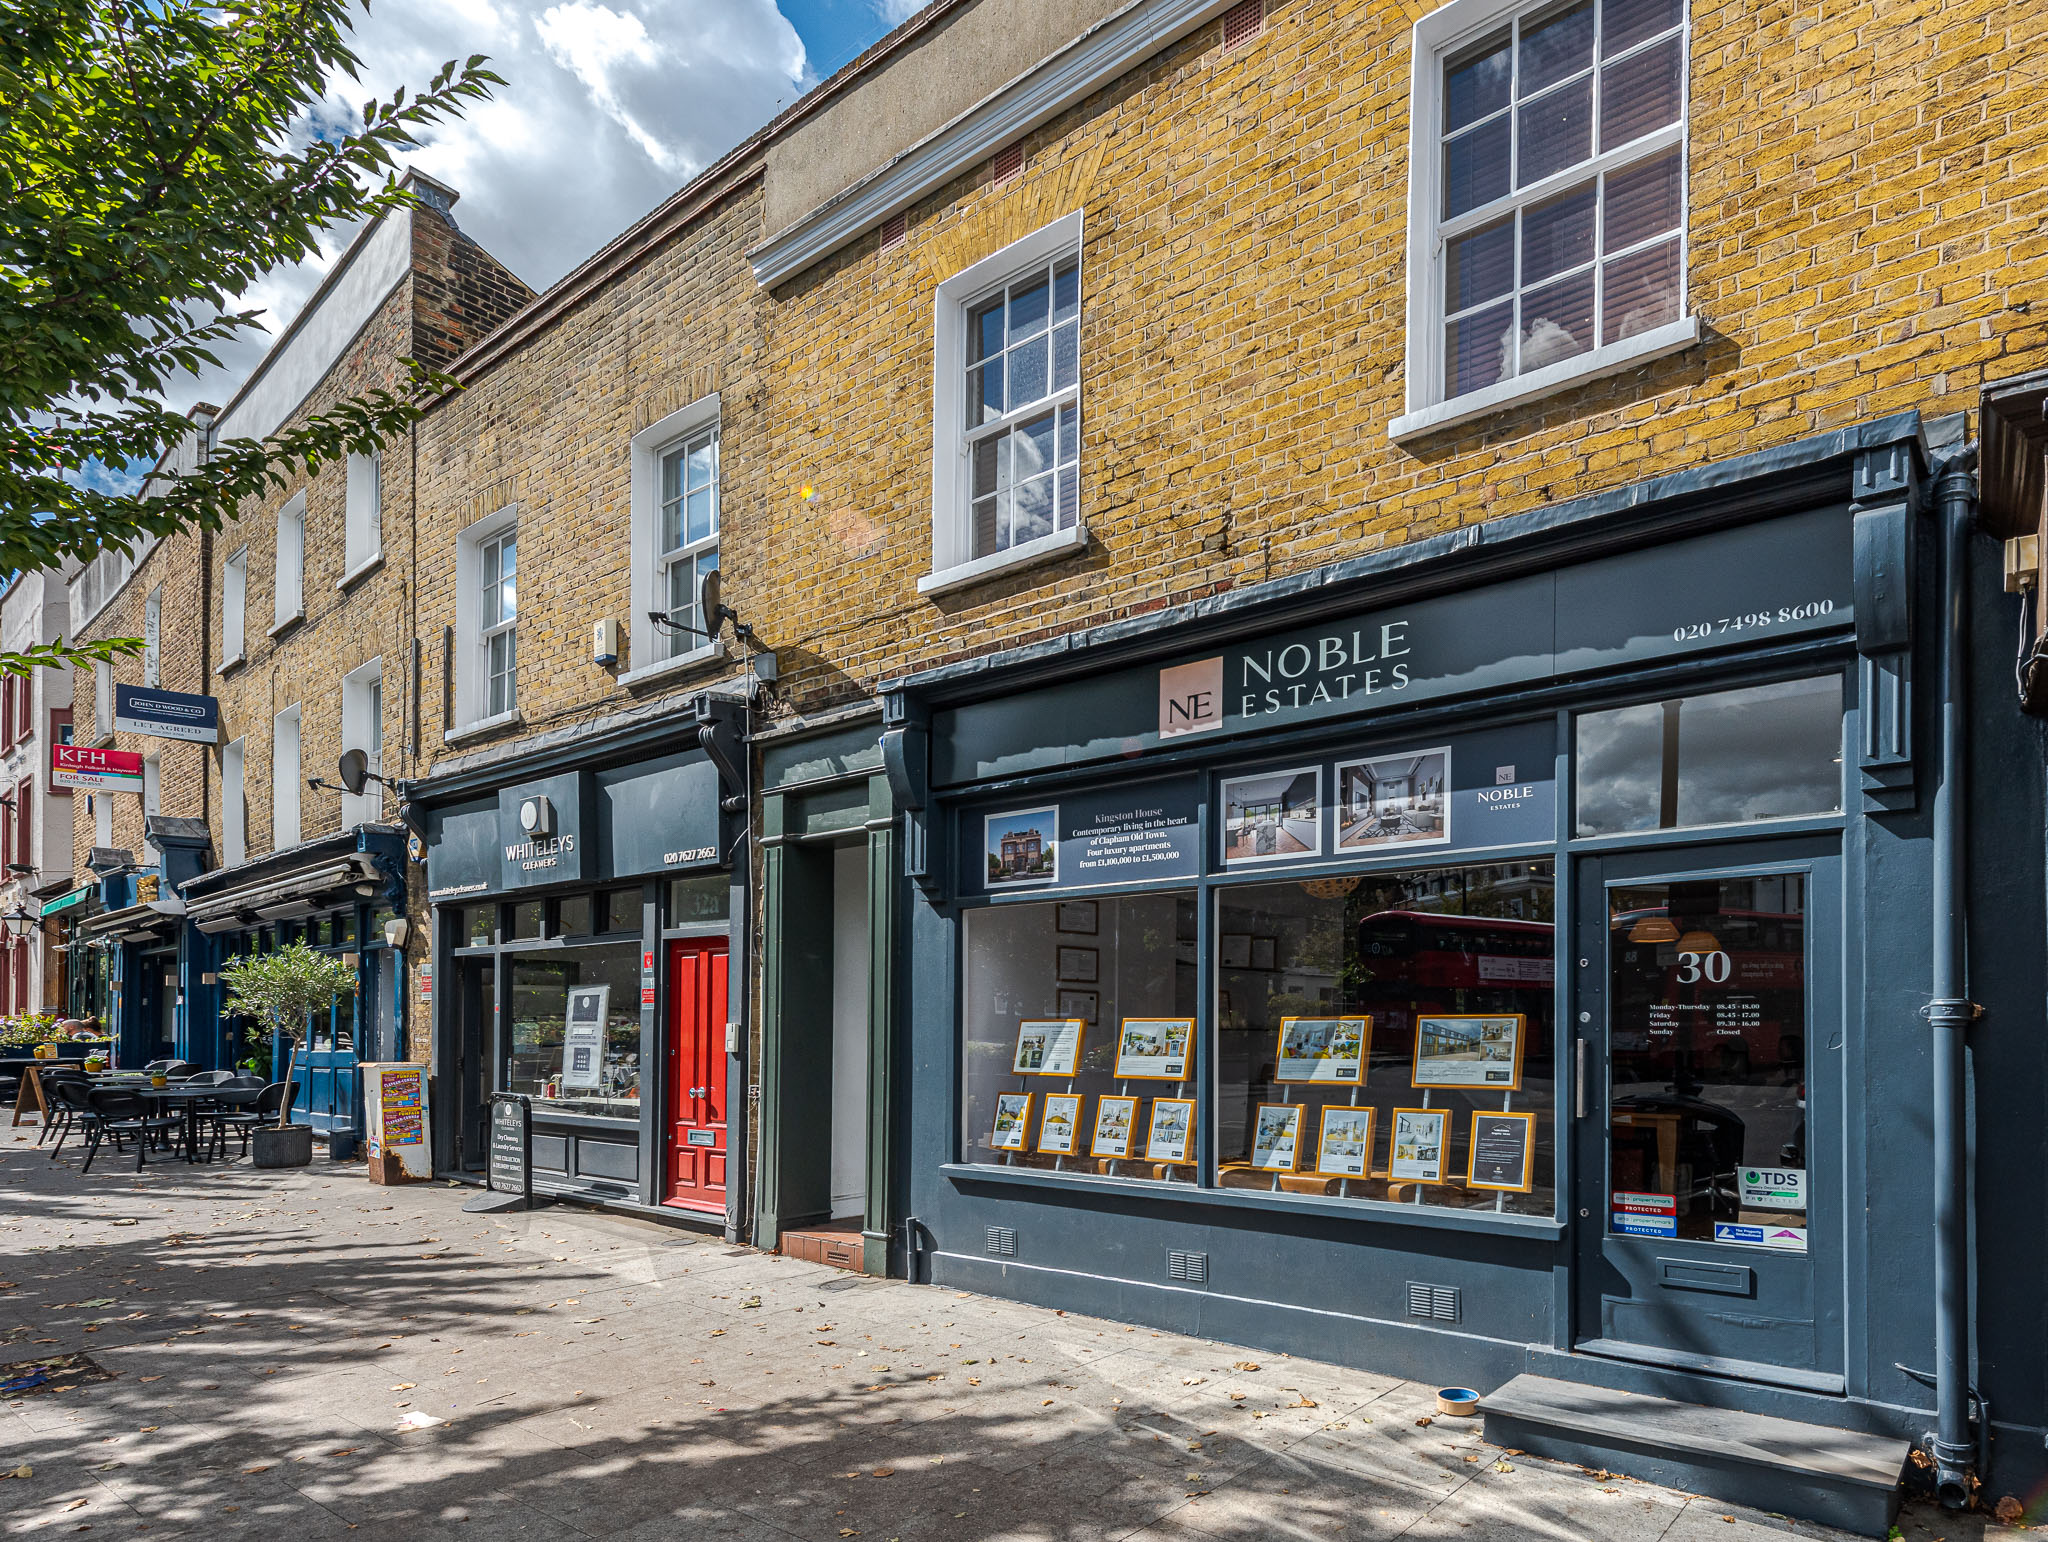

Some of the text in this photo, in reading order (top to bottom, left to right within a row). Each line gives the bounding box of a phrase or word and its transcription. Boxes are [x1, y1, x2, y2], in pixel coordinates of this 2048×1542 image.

[1673, 599, 1834, 642] 020 7498 8600
[1242, 620, 1411, 687] NOBLE
[1242, 663, 1409, 718] ESTATES
[162, 704, 184, 712] WOOD
[1168, 691, 1213, 724] NE
[133, 721, 155, 729] LET
[159, 725, 202, 735] AGREED
[59, 748, 106, 765] KFH
[82, 775, 105, 783] SALE
[1499, 772, 1512, 781] NE
[1477, 786, 1534, 803] NOBLE
[1490, 802, 1521, 811] ESTATES
[1095, 807, 1163, 824] Kingston House
[1072, 816, 1188, 837] Contemporary living in the heart
[1090, 831, 1168, 846] of Clapham Old Town.
[505, 834, 574, 861] WHITELEYS
[663, 846, 716, 864] 020 7627 2662
[1087, 842, 1171, 857] Four luxury apartments
[522, 858, 557, 871] CLEANERS
[1079, 851, 1180, 869] from £1,100,000 to £1,500,000
[1676, 951, 1732, 983] 30
[494, 1118, 522, 1128] WHITELEYS
[509, 1144, 523, 1152] Services
[1761, 1172, 1798, 1186] TDS
[1625, 1205, 1662, 1213] PROTECTED
[1632, 1217, 1671, 1225] propertymark
[1625, 1226, 1662, 1234] PROTECTED
